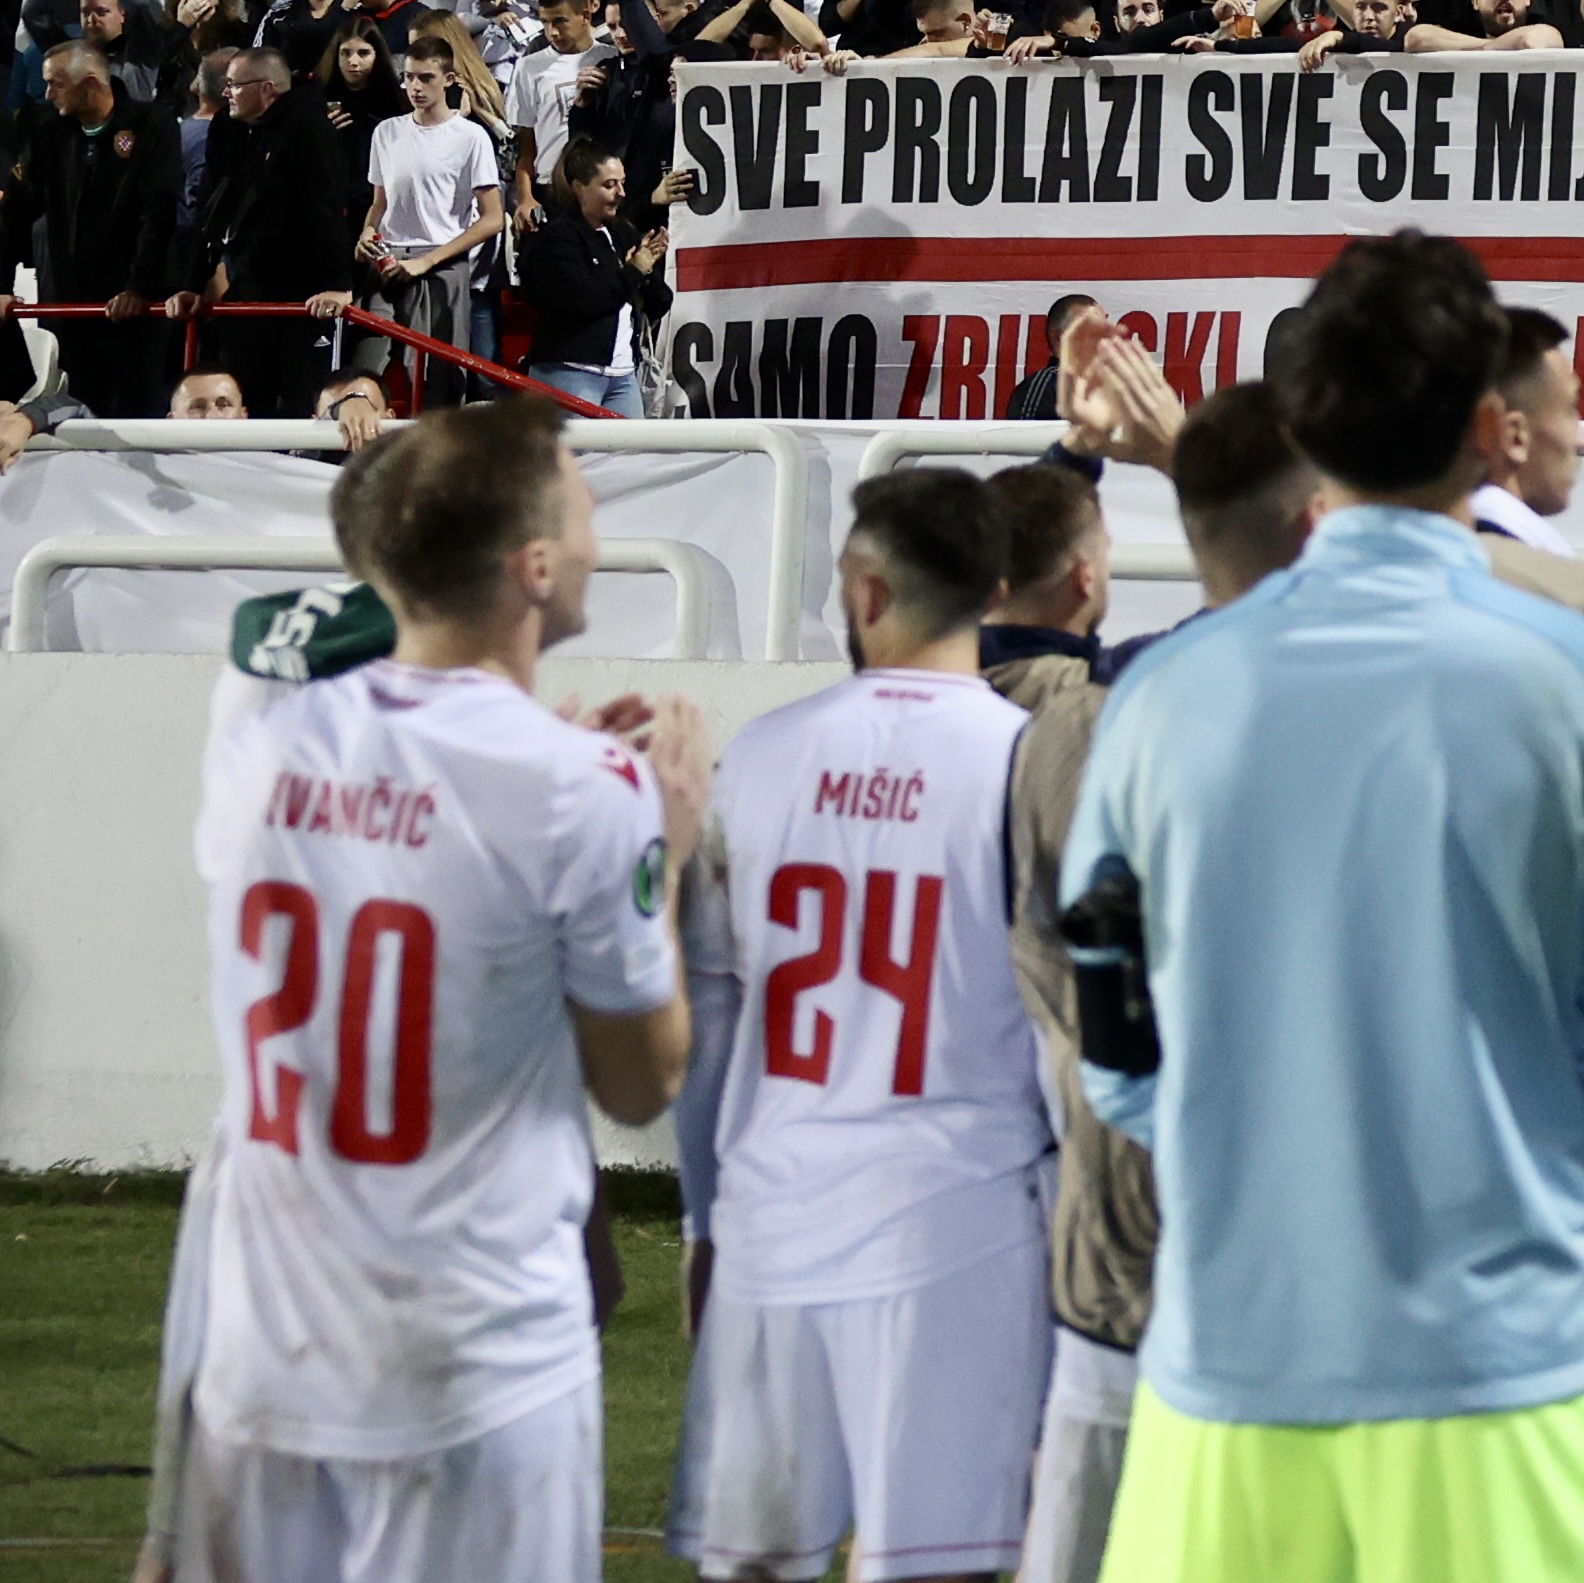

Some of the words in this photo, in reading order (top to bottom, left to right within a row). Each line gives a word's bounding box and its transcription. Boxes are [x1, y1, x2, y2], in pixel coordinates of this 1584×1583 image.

[682, 80, 822, 216] SVE
[841, 73, 1164, 206] PROLAZI
[1185, 70, 1333, 204] SVE
[1357, 70, 1452, 204] SE
[672, 313, 878, 421] SAMO
[264, 768, 440, 850] IVANČIĆ
[813, 767, 925, 823] MIŠIĆ
[238, 880, 438, 1166] 20
[764, 862, 944, 1097] 24
